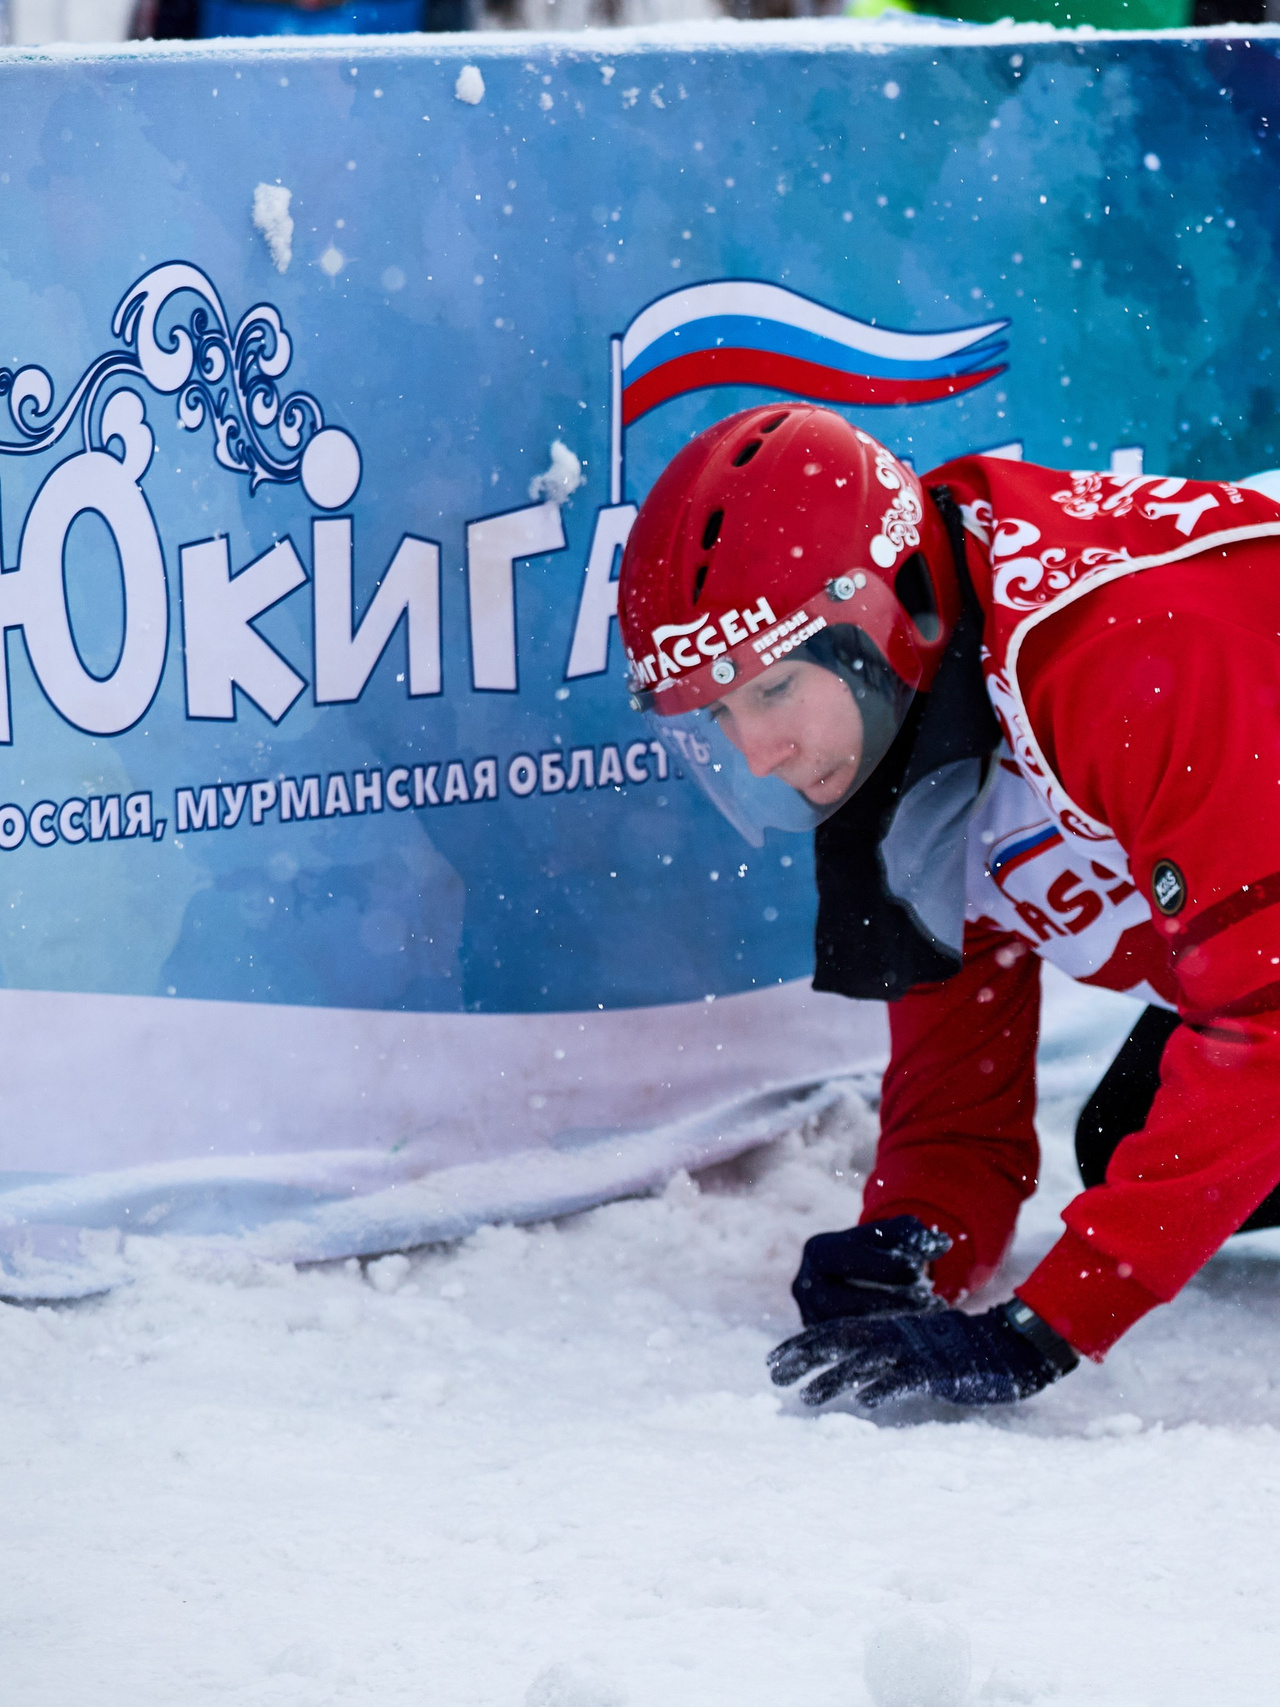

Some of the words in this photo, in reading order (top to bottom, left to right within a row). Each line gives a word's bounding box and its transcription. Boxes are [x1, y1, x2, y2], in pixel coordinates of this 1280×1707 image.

[630, 597, 777, 684] ИГАССЕН
[752, 610, 809, 653] ПЕРВЫЕ
[771, 616, 827, 659] РОССИИ
[176, 757, 499, 835] МУРМАНСКАЯ
